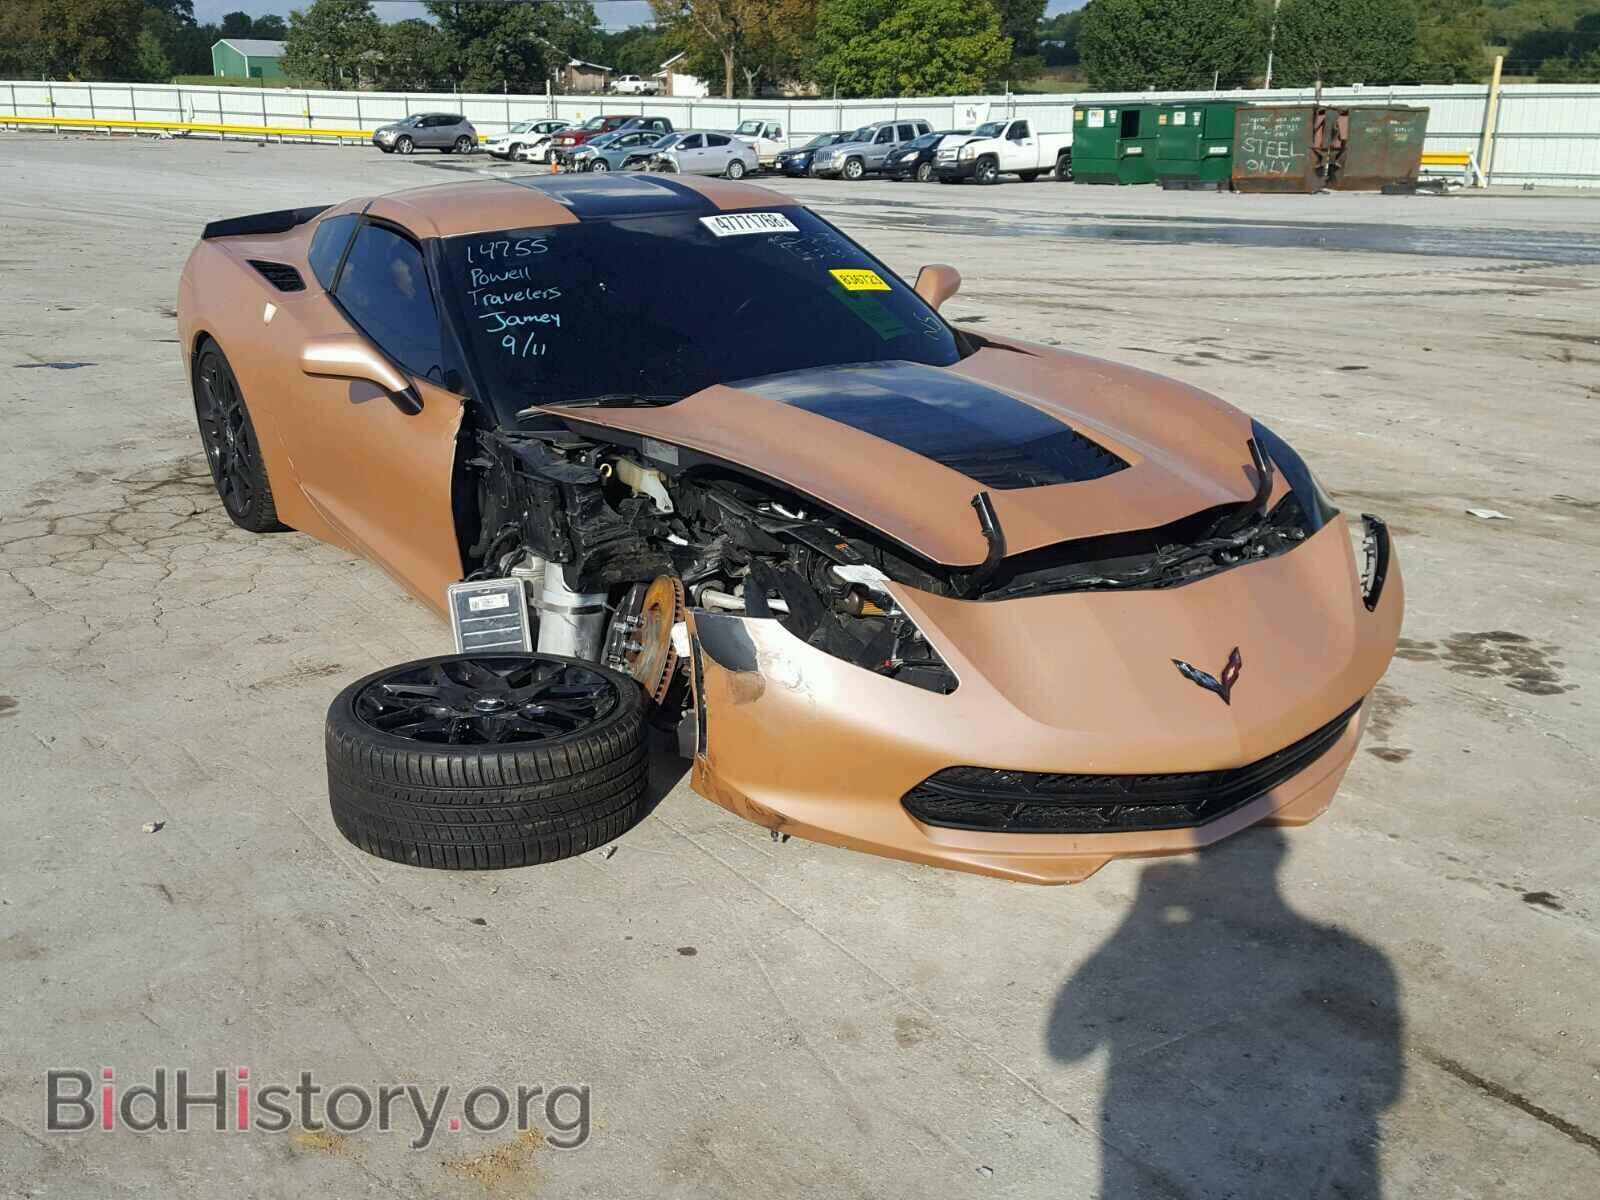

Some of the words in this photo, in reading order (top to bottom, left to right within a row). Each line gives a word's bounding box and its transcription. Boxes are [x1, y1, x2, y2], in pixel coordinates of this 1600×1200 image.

[1241, 137, 1304, 159] STEEL
[470, 266, 532, 287] Powell
[466, 286, 562, 306] Travelers
[502, 332, 546, 357] 9/11
